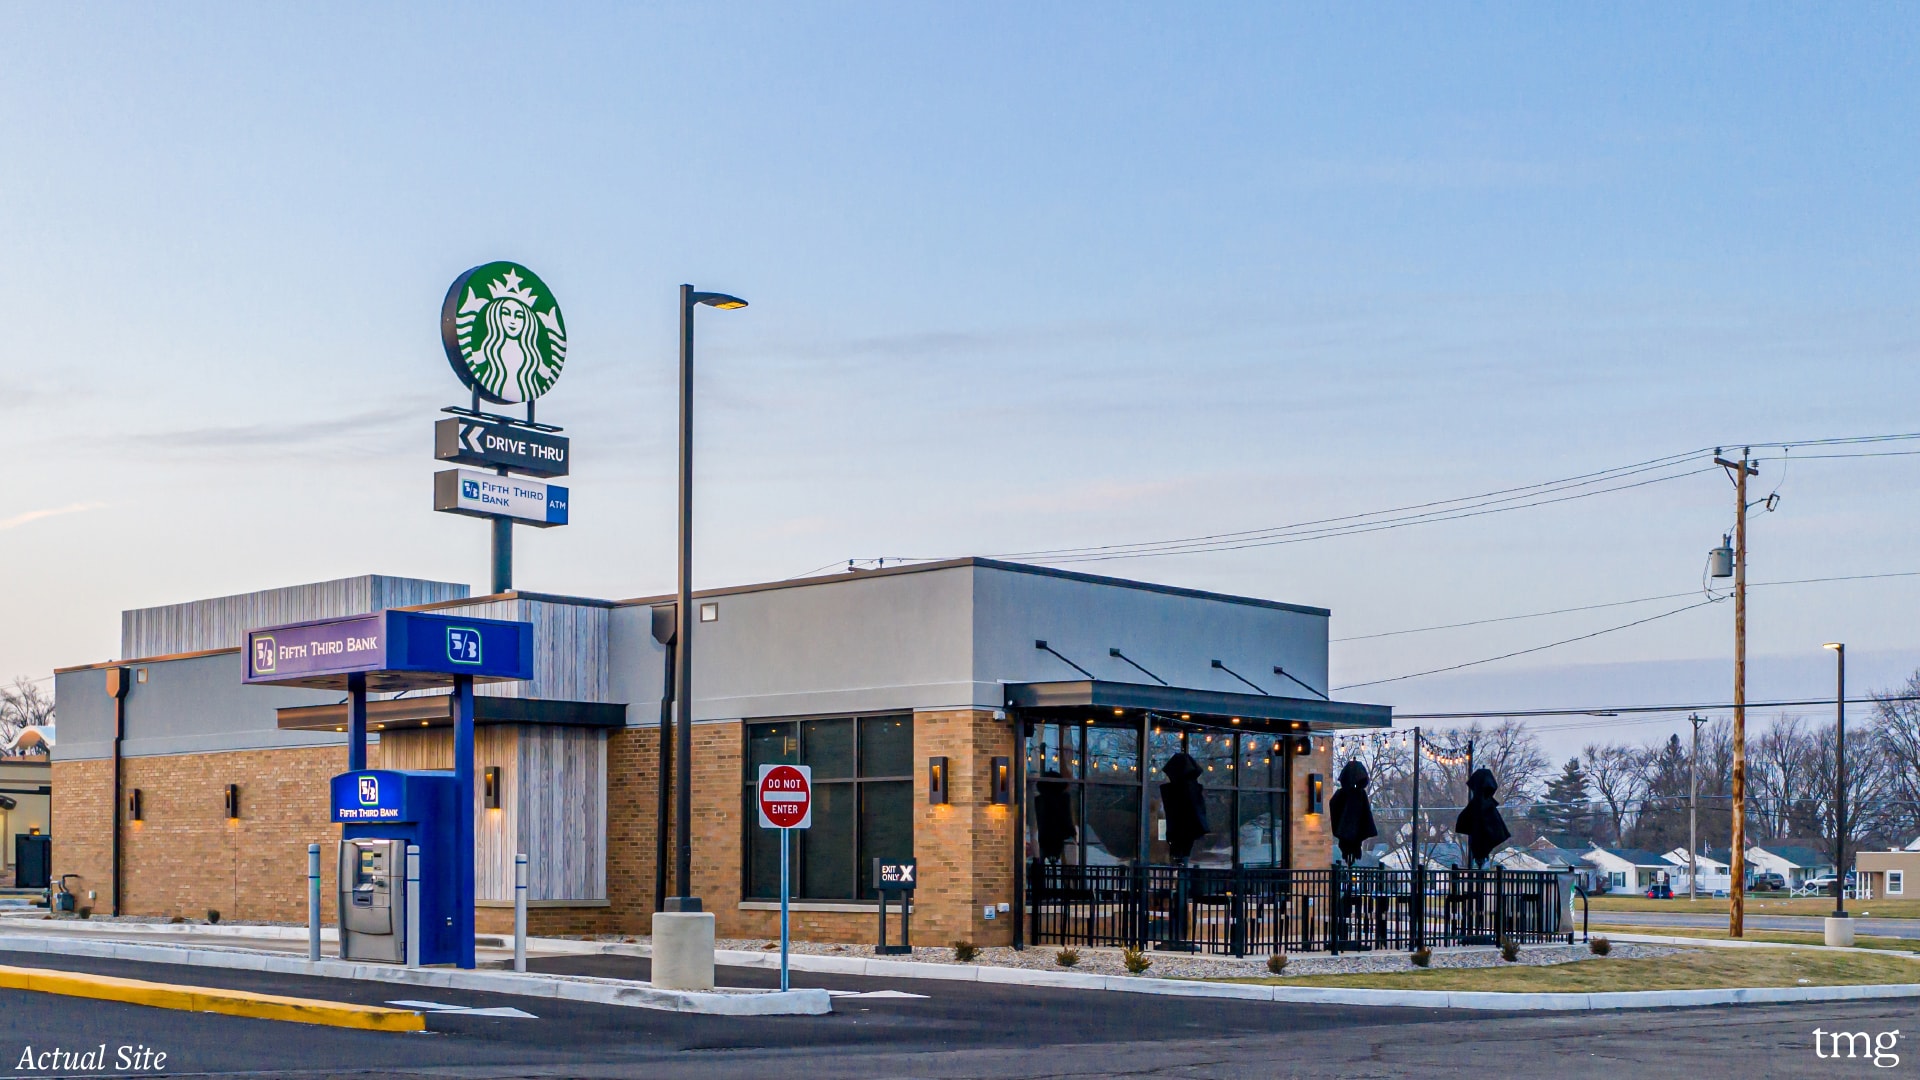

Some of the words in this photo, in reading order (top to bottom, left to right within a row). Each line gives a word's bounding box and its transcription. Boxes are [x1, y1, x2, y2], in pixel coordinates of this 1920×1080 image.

[486, 435, 526, 455] DRIVE
[530, 444, 564, 462] THRU
[549, 500, 566, 510] ATM
[768, 779, 780, 789] DO
[783, 779, 801, 789] NOT
[772, 804, 798, 814] ENTER
[881, 865, 896, 874] EXIT
[881, 873, 900, 881] ONLY
